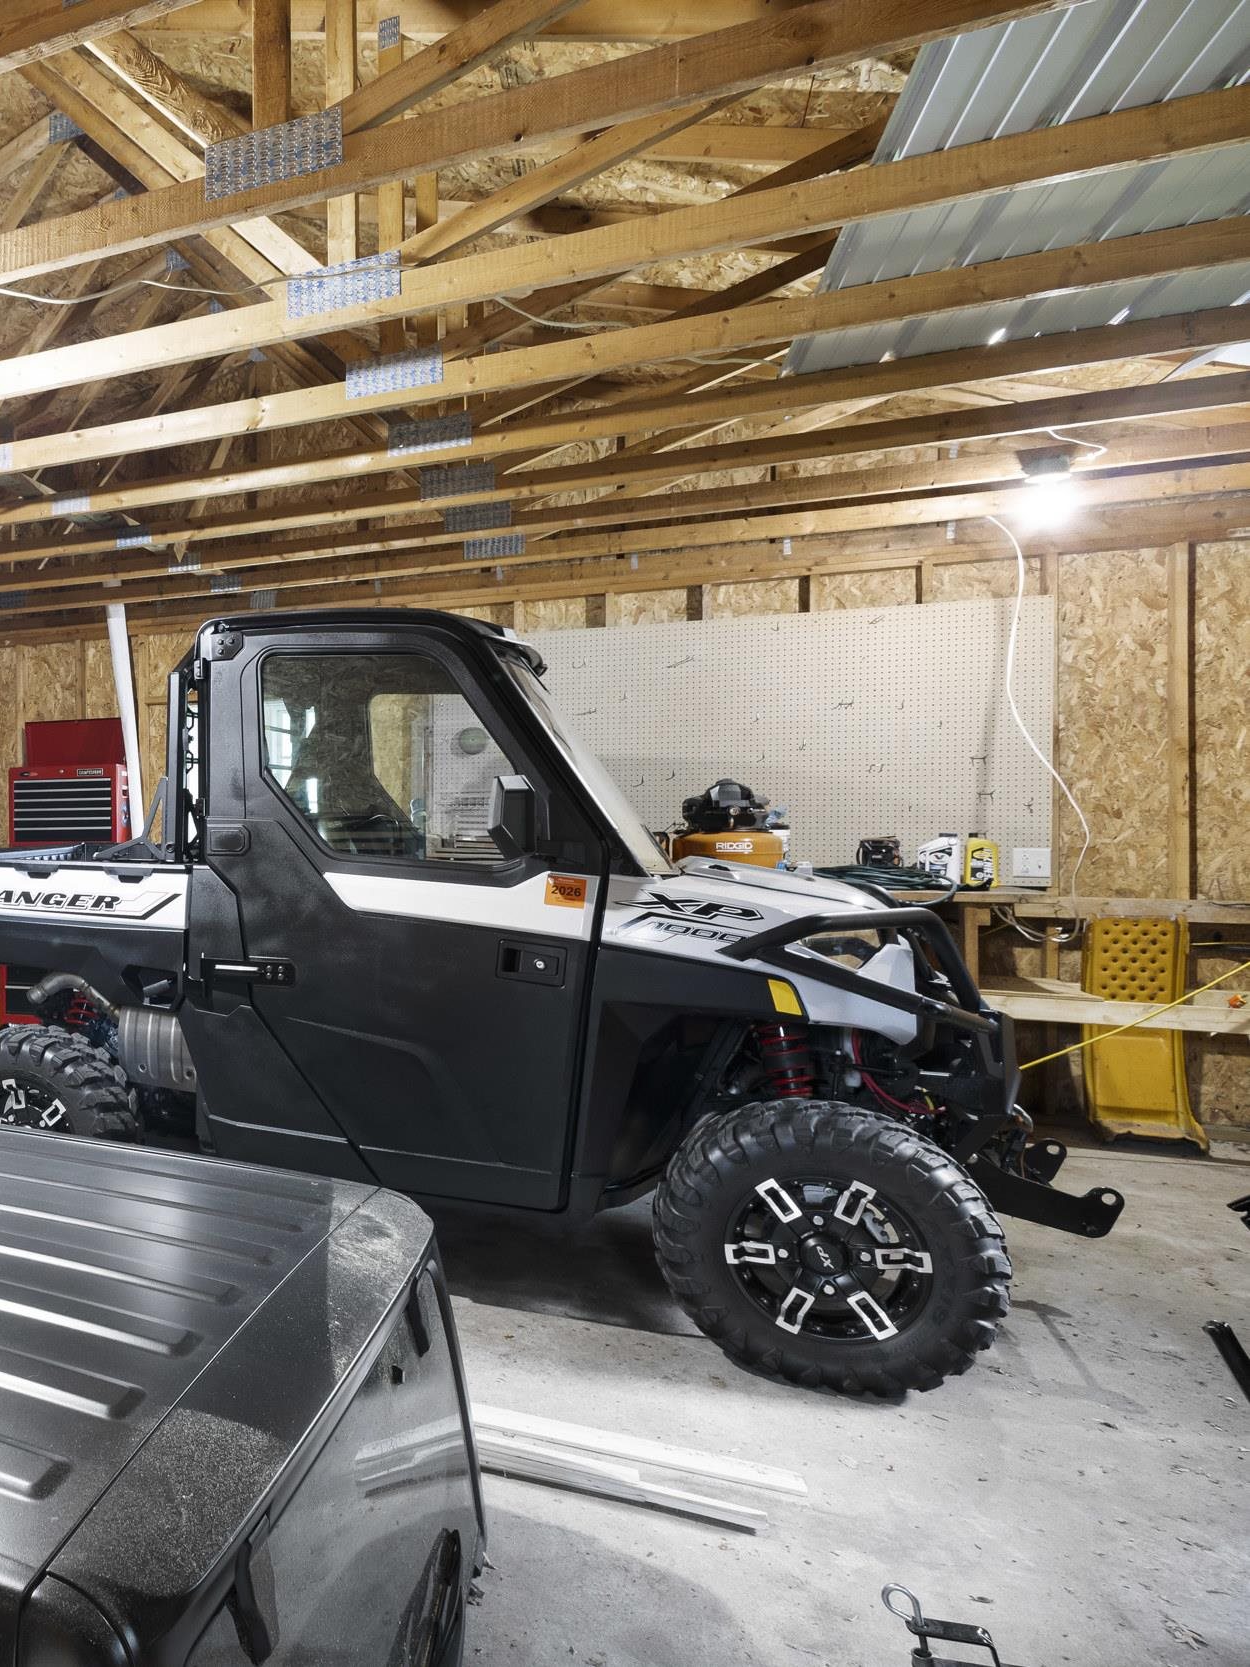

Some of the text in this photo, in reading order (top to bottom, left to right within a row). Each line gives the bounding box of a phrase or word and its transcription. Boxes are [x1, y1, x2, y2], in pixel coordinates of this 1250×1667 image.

[715, 841, 753, 850] RIDGID
[551, 885, 582, 897] 2026
[614, 889, 764, 921] XP
[816, 1246, 835, 1269] XP
